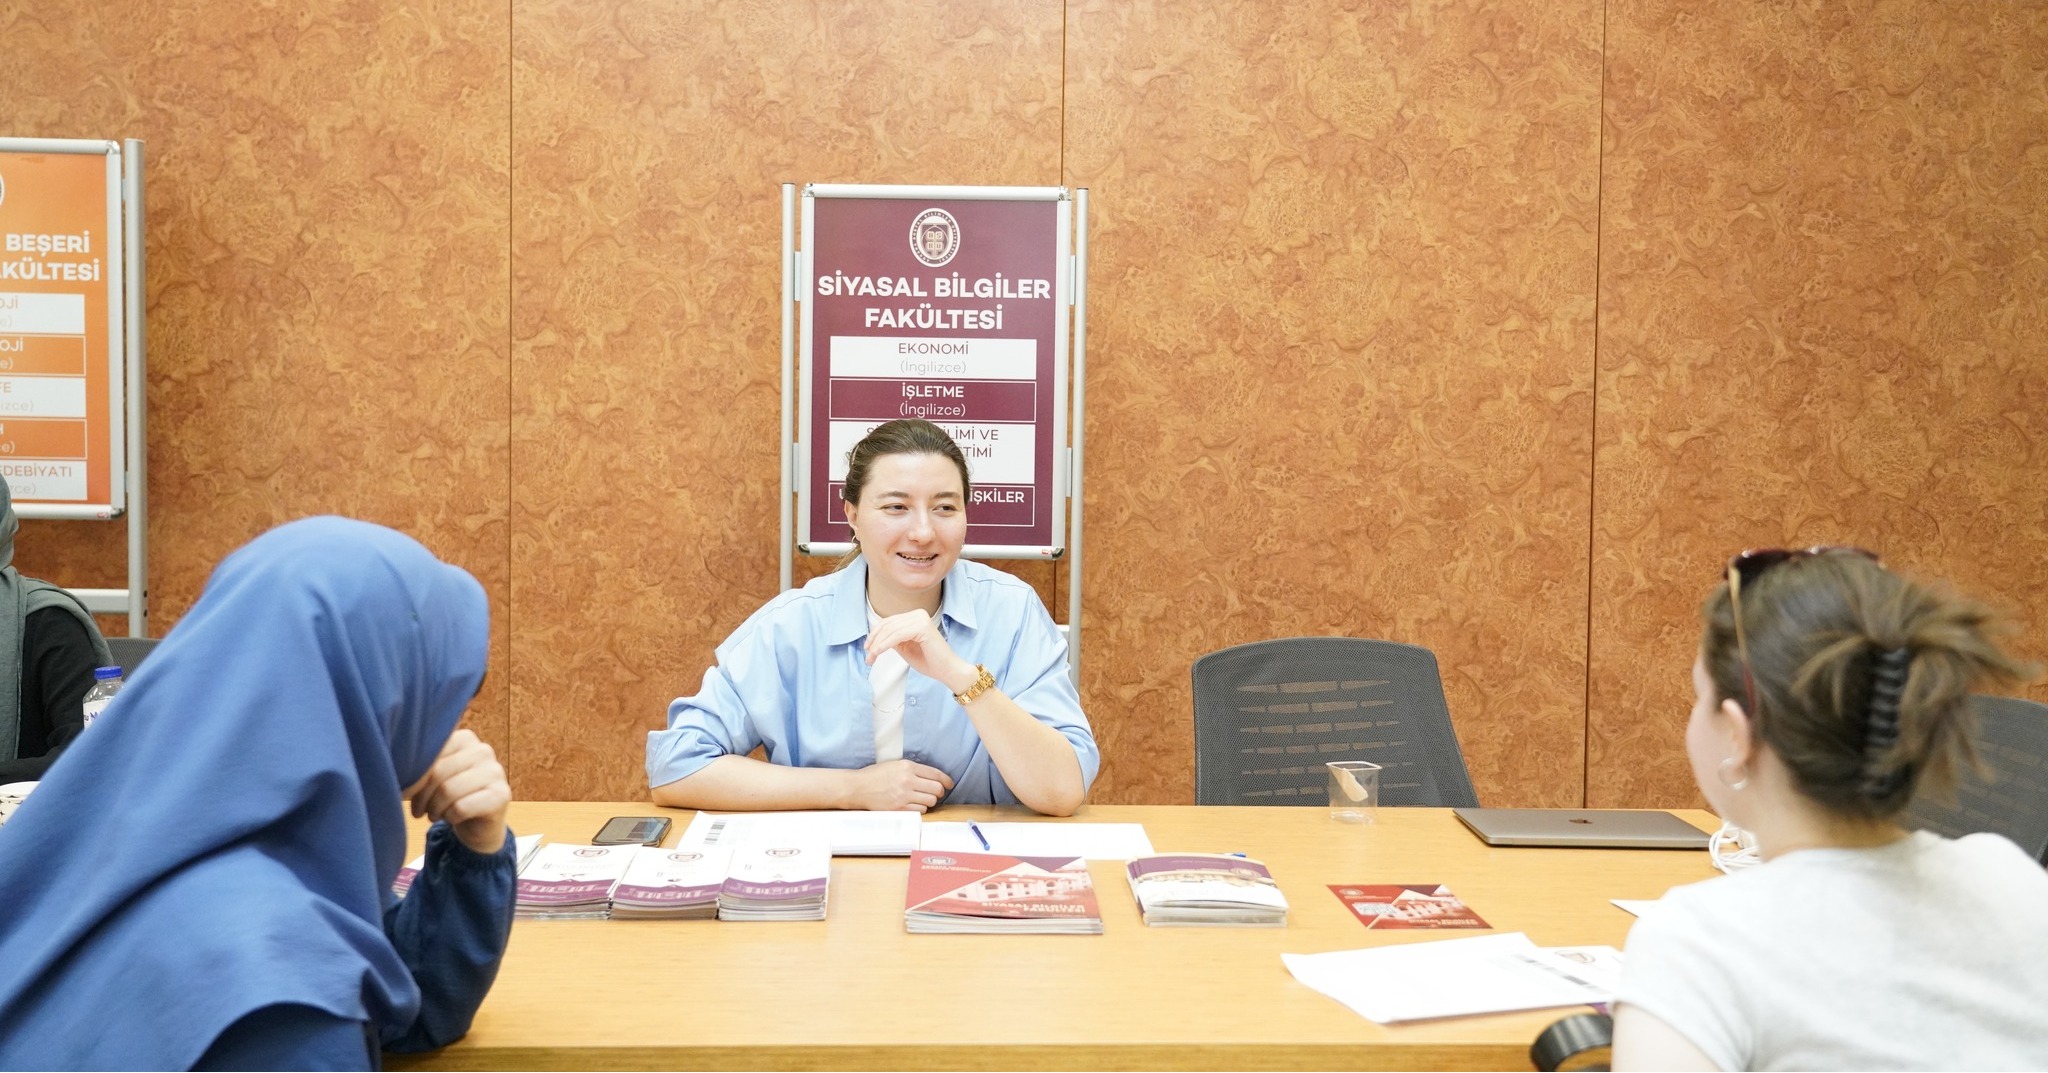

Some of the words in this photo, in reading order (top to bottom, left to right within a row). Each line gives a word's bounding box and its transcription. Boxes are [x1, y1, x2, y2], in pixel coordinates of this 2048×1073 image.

[6, 230, 90, 257] BEŞERİ
[0, 257, 100, 281] KÜLTESİ
[818, 270, 928, 297] SİYASAL
[935, 271, 1051, 299] BİLGİLER
[865, 303, 1003, 330] FAKÜLTESİ
[898, 341, 969, 355] EKONOMİ
[900, 360, 967, 376] (İngilizce)
[902, 382, 965, 400] İŞLETME
[899, 401, 966, 418] (İngilizce)
[979, 429, 999, 441] VE
[959, 444, 992, 458] TİMİ
[969, 488, 1025, 505] İŞKİLER
